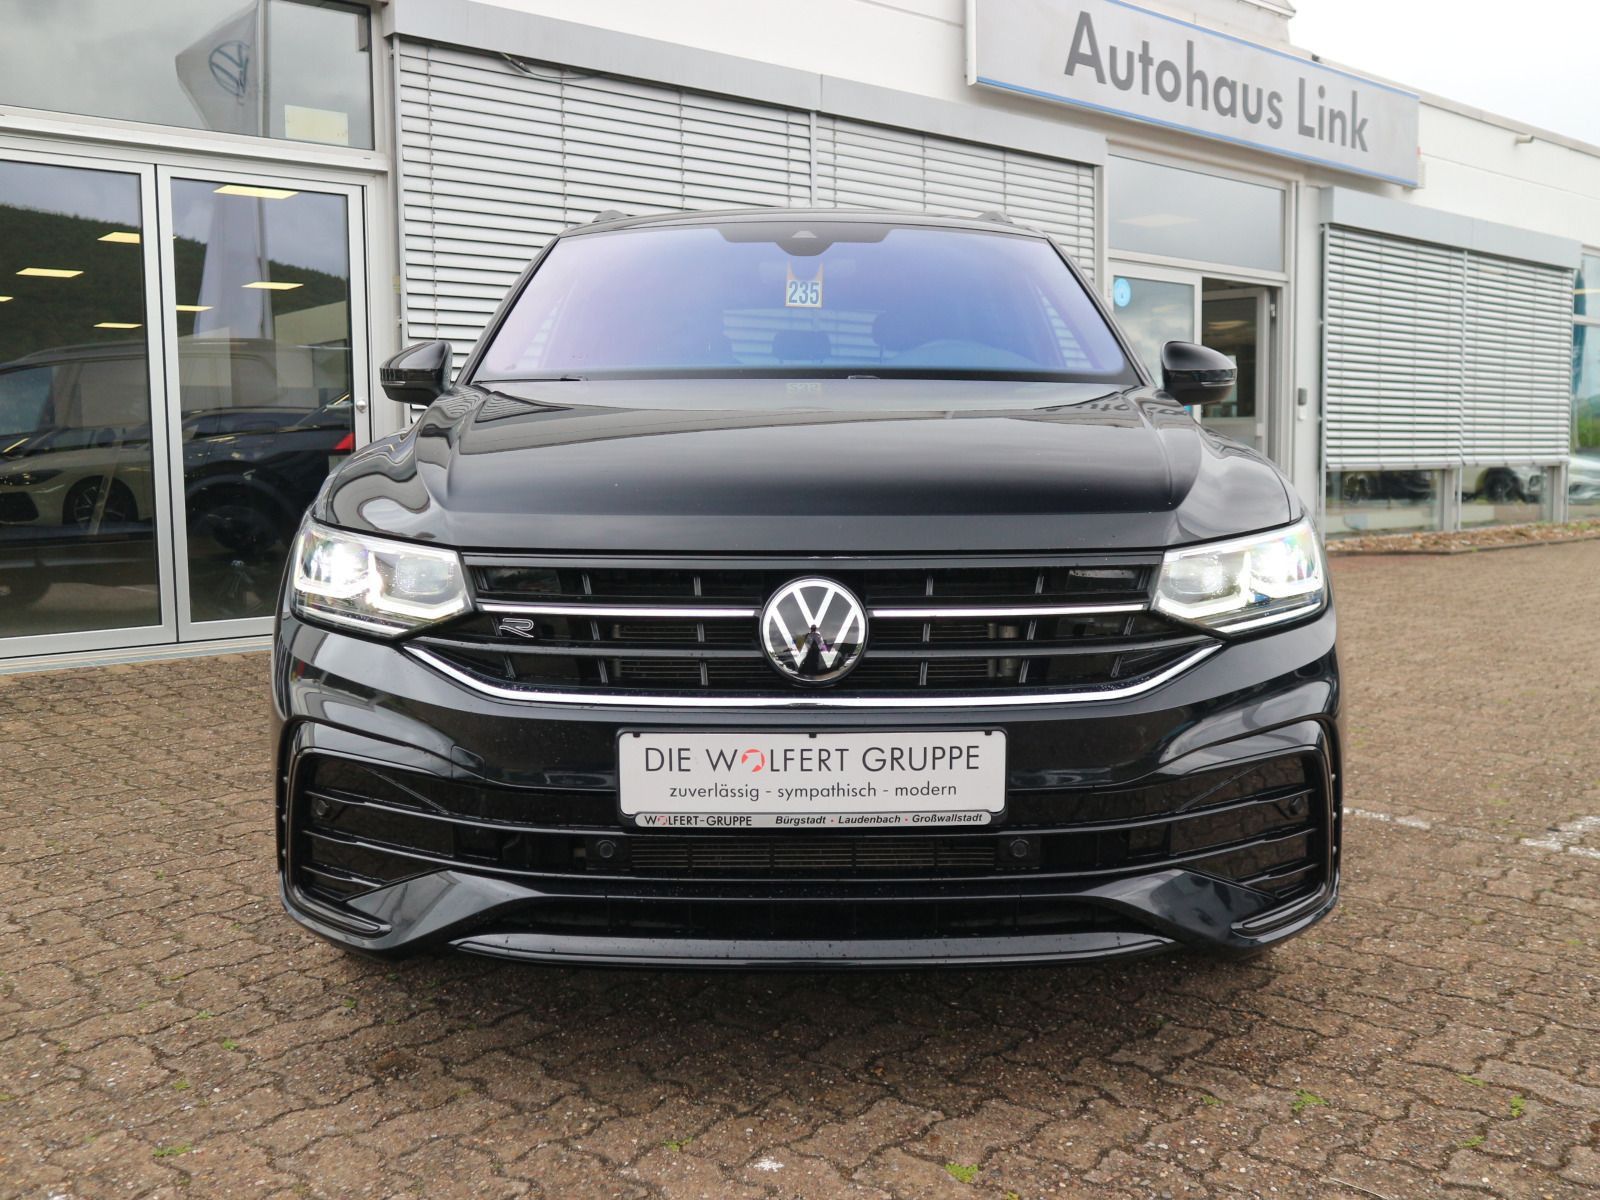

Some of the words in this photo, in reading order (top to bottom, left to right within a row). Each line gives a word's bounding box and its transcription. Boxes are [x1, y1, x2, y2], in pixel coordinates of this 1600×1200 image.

[1064, 11, 1284, 130] Autohaus
[1298, 78, 1369, 153] Link
[788, 281, 819, 304] 235
[645, 746, 691, 772] DIE
[706, 747, 849, 773] WOLFERT
[861, 744, 980, 772] GRUPPE
[669, 782, 759, 802] zuverlässig
[777, 780, 876, 800] sympathisch
[895, 781, 957, 797] modern
[776, 815, 826, 827] Bürgstadt
[838, 814, 901, 825] Laudenbach
[911, 813, 983, 825] Großwallstadt
